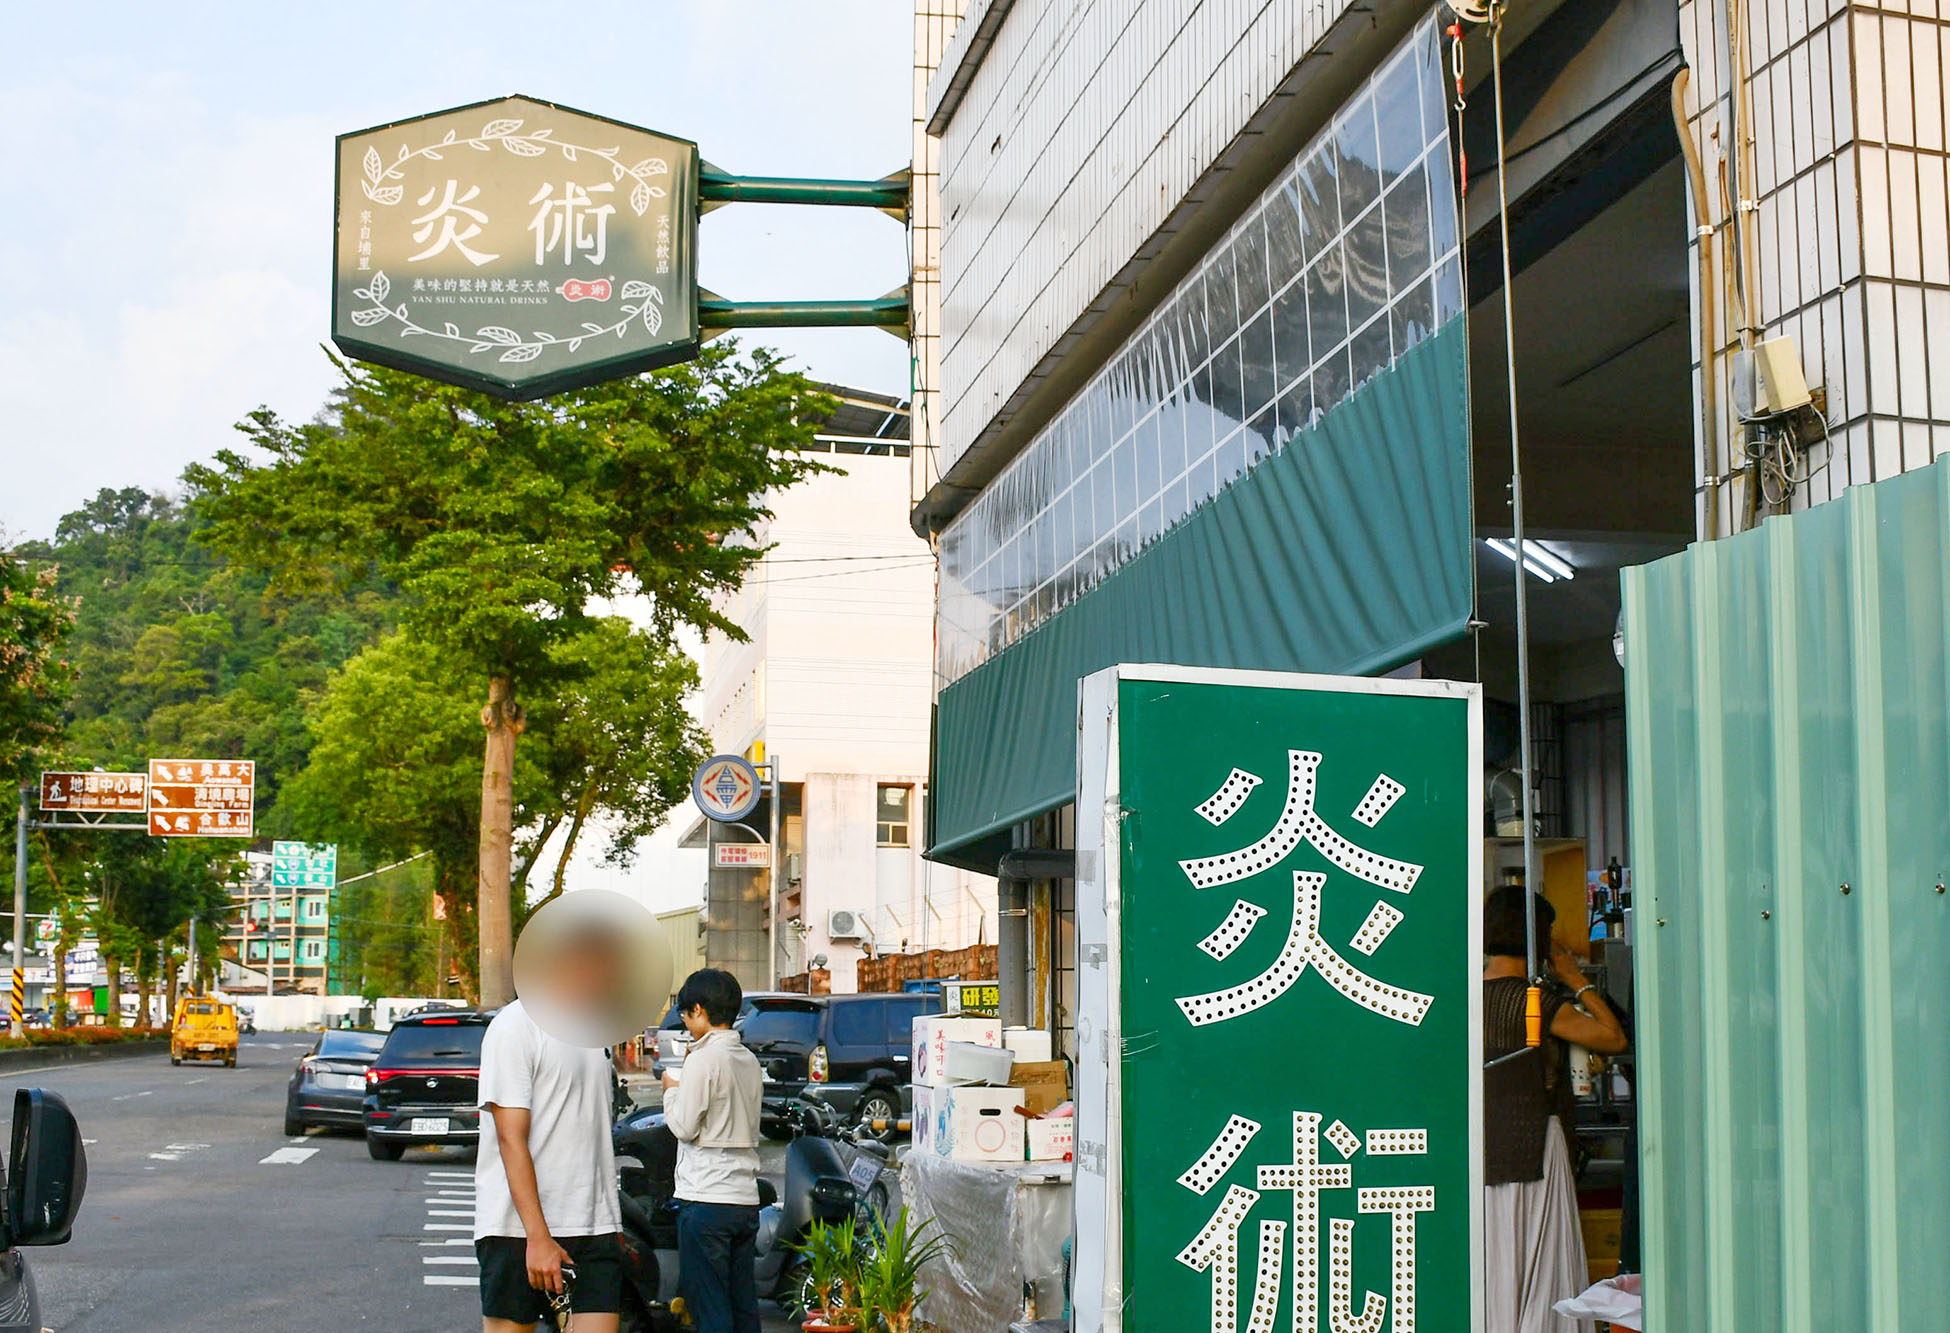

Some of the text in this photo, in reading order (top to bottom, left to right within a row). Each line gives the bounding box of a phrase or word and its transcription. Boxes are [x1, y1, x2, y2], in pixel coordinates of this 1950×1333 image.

[408, 179, 616, 267] 炎術
[412, 278, 550, 293] 美味的堅持就是天然
[412, 295, 549, 305] YAN SHU NATURAL DRINKS
[1175, 749, 1436, 1333] 炎術
